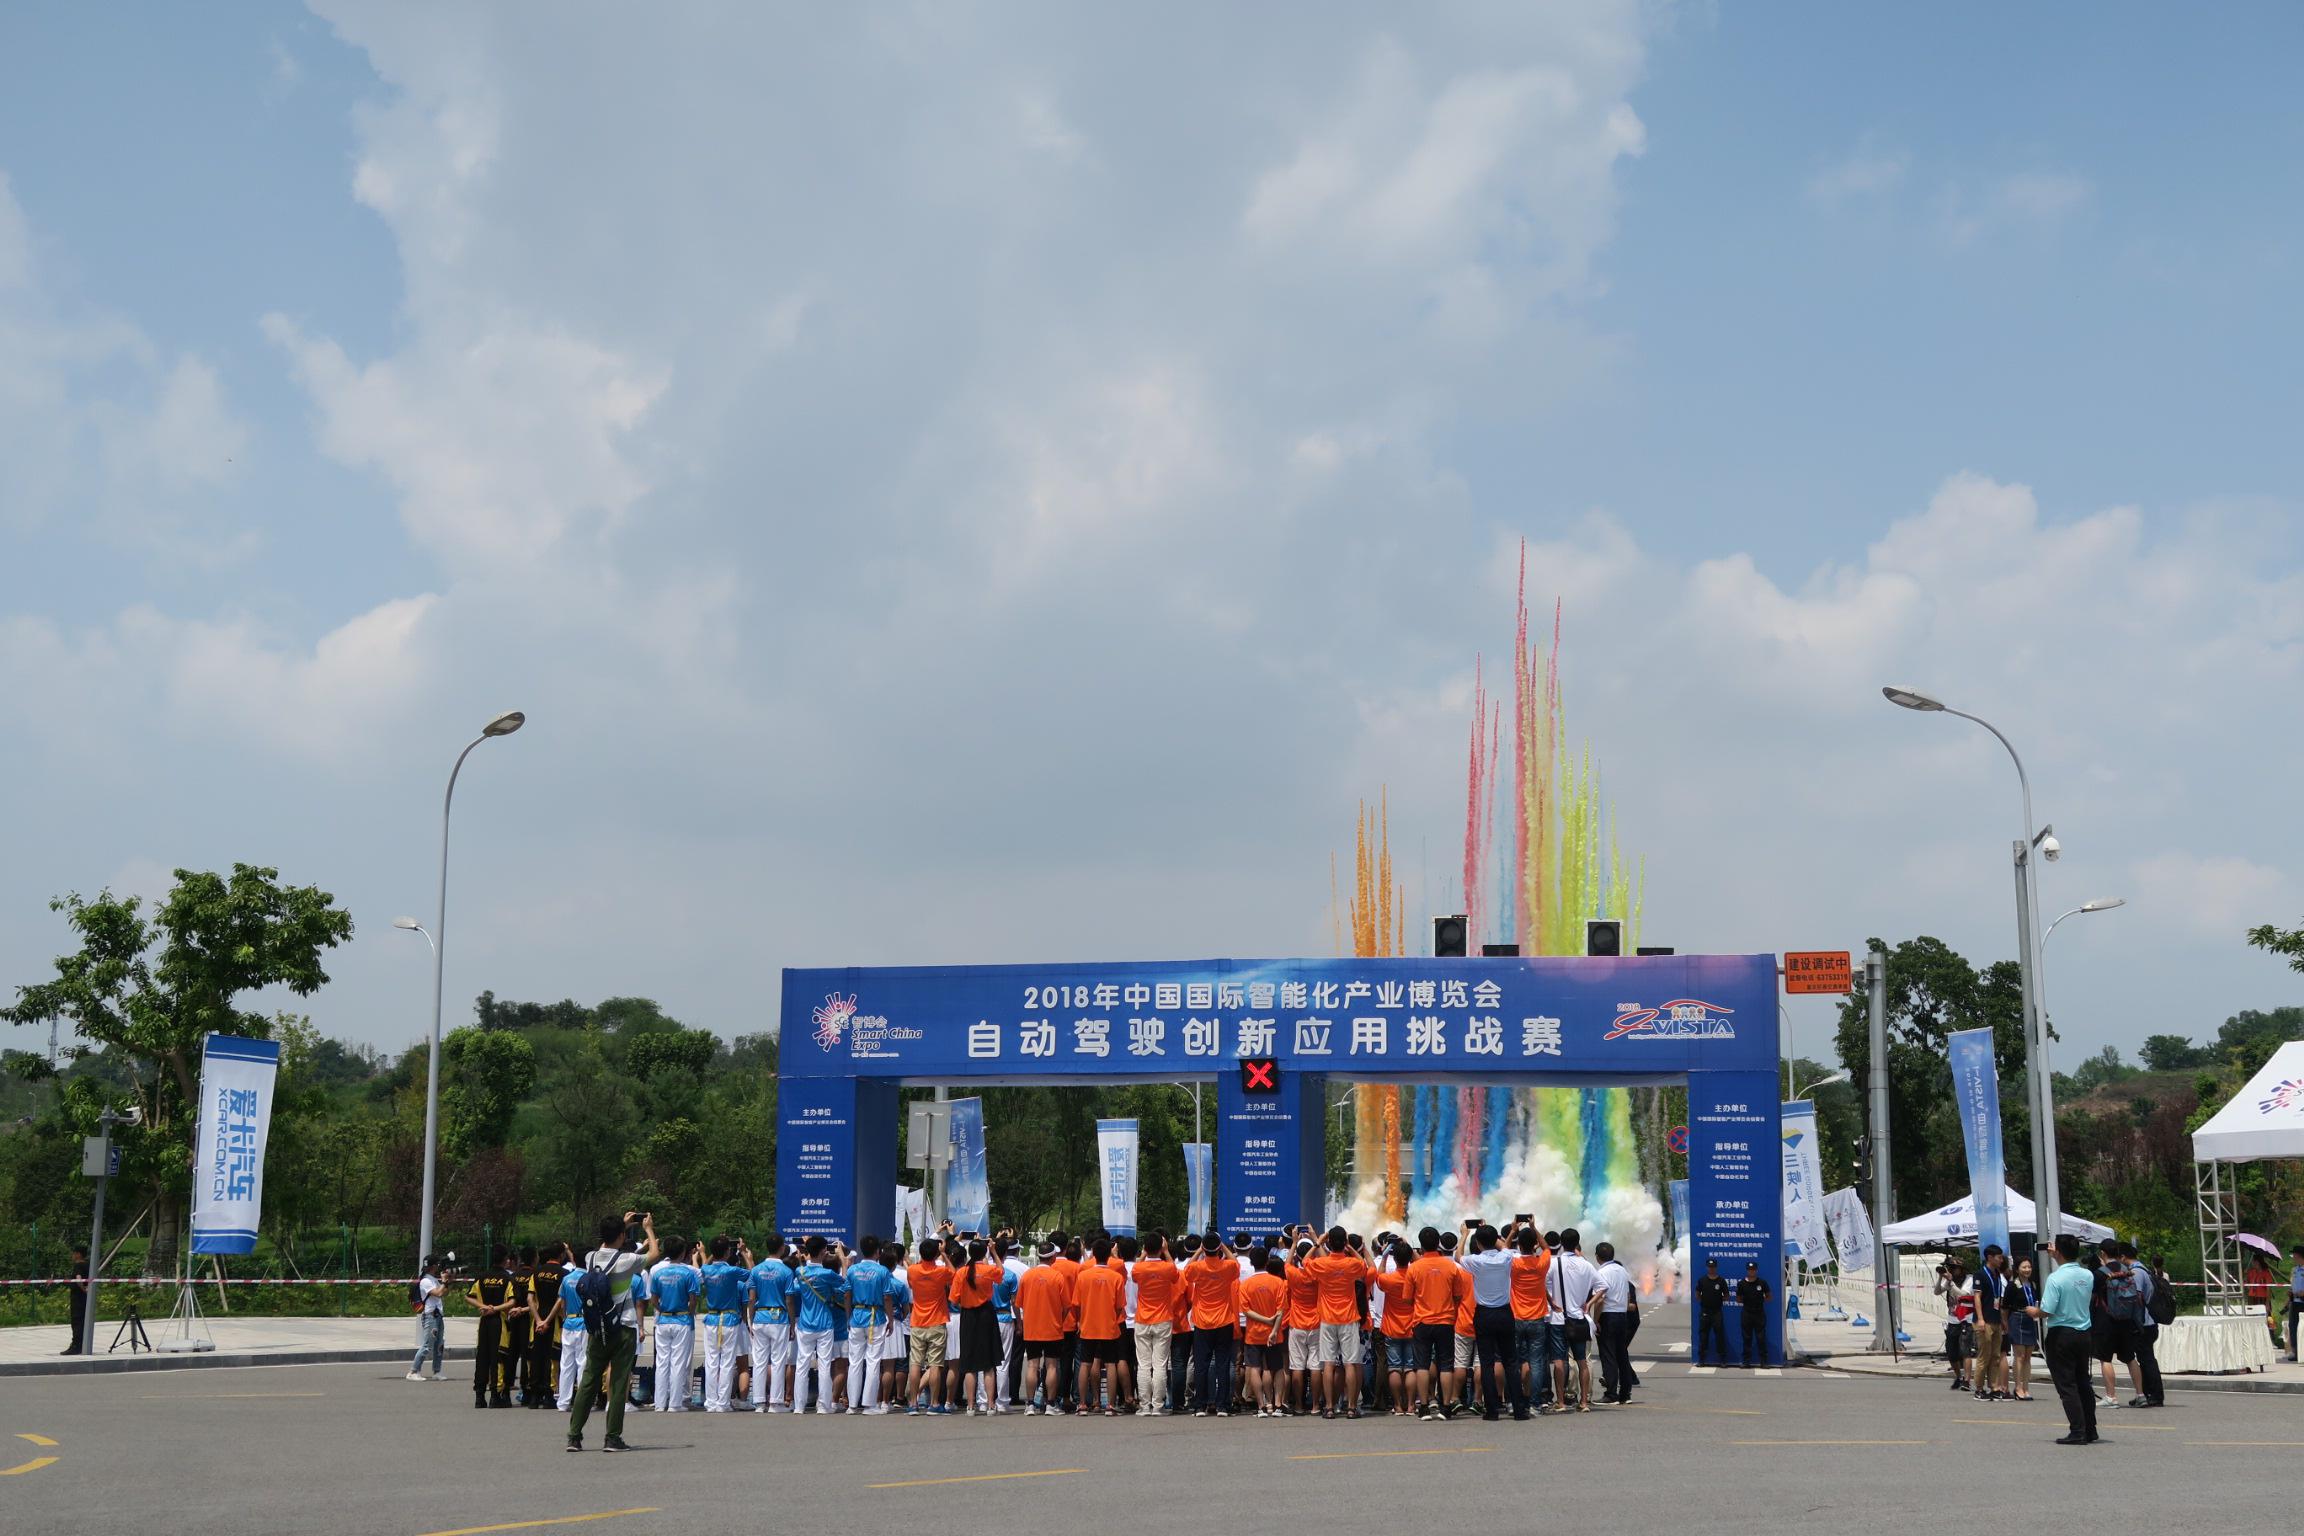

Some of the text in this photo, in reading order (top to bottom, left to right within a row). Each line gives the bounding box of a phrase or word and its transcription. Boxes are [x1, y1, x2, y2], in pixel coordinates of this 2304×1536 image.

[1788, 956, 1848, 971] 建设调试中
[1023, 977, 1502, 1010] 2018年中国国际智能化产业博览会
[1617, 1002, 1641, 1012] 2018
[851, 1027, 923, 1040] Smart China
[968, 1015, 1562, 1058] 自动驾驶创新应用挑战赛
[851, 1040, 881, 1053] Expo
[1245, 1102, 1276, 1112] 主办单位
[1714, 1103, 1748, 1113] 主办单位
[802, 1108, 832, 1117] 主办单位
[213, 1087, 228, 1201] XCAR.COM.CN
[228, 1088, 257, 1201] 爱卡汽车
[802, 1144, 831, 1153] 指导单位
[1245, 1139, 1276, 1149] 指导单位
[1715, 1142, 1748, 1151] 指导单位
[800, 1198, 830, 1207] 承办单位
[1244, 1195, 1276, 1205] 承办单位
[1715, 1200, 1749, 1210] 承办单位
